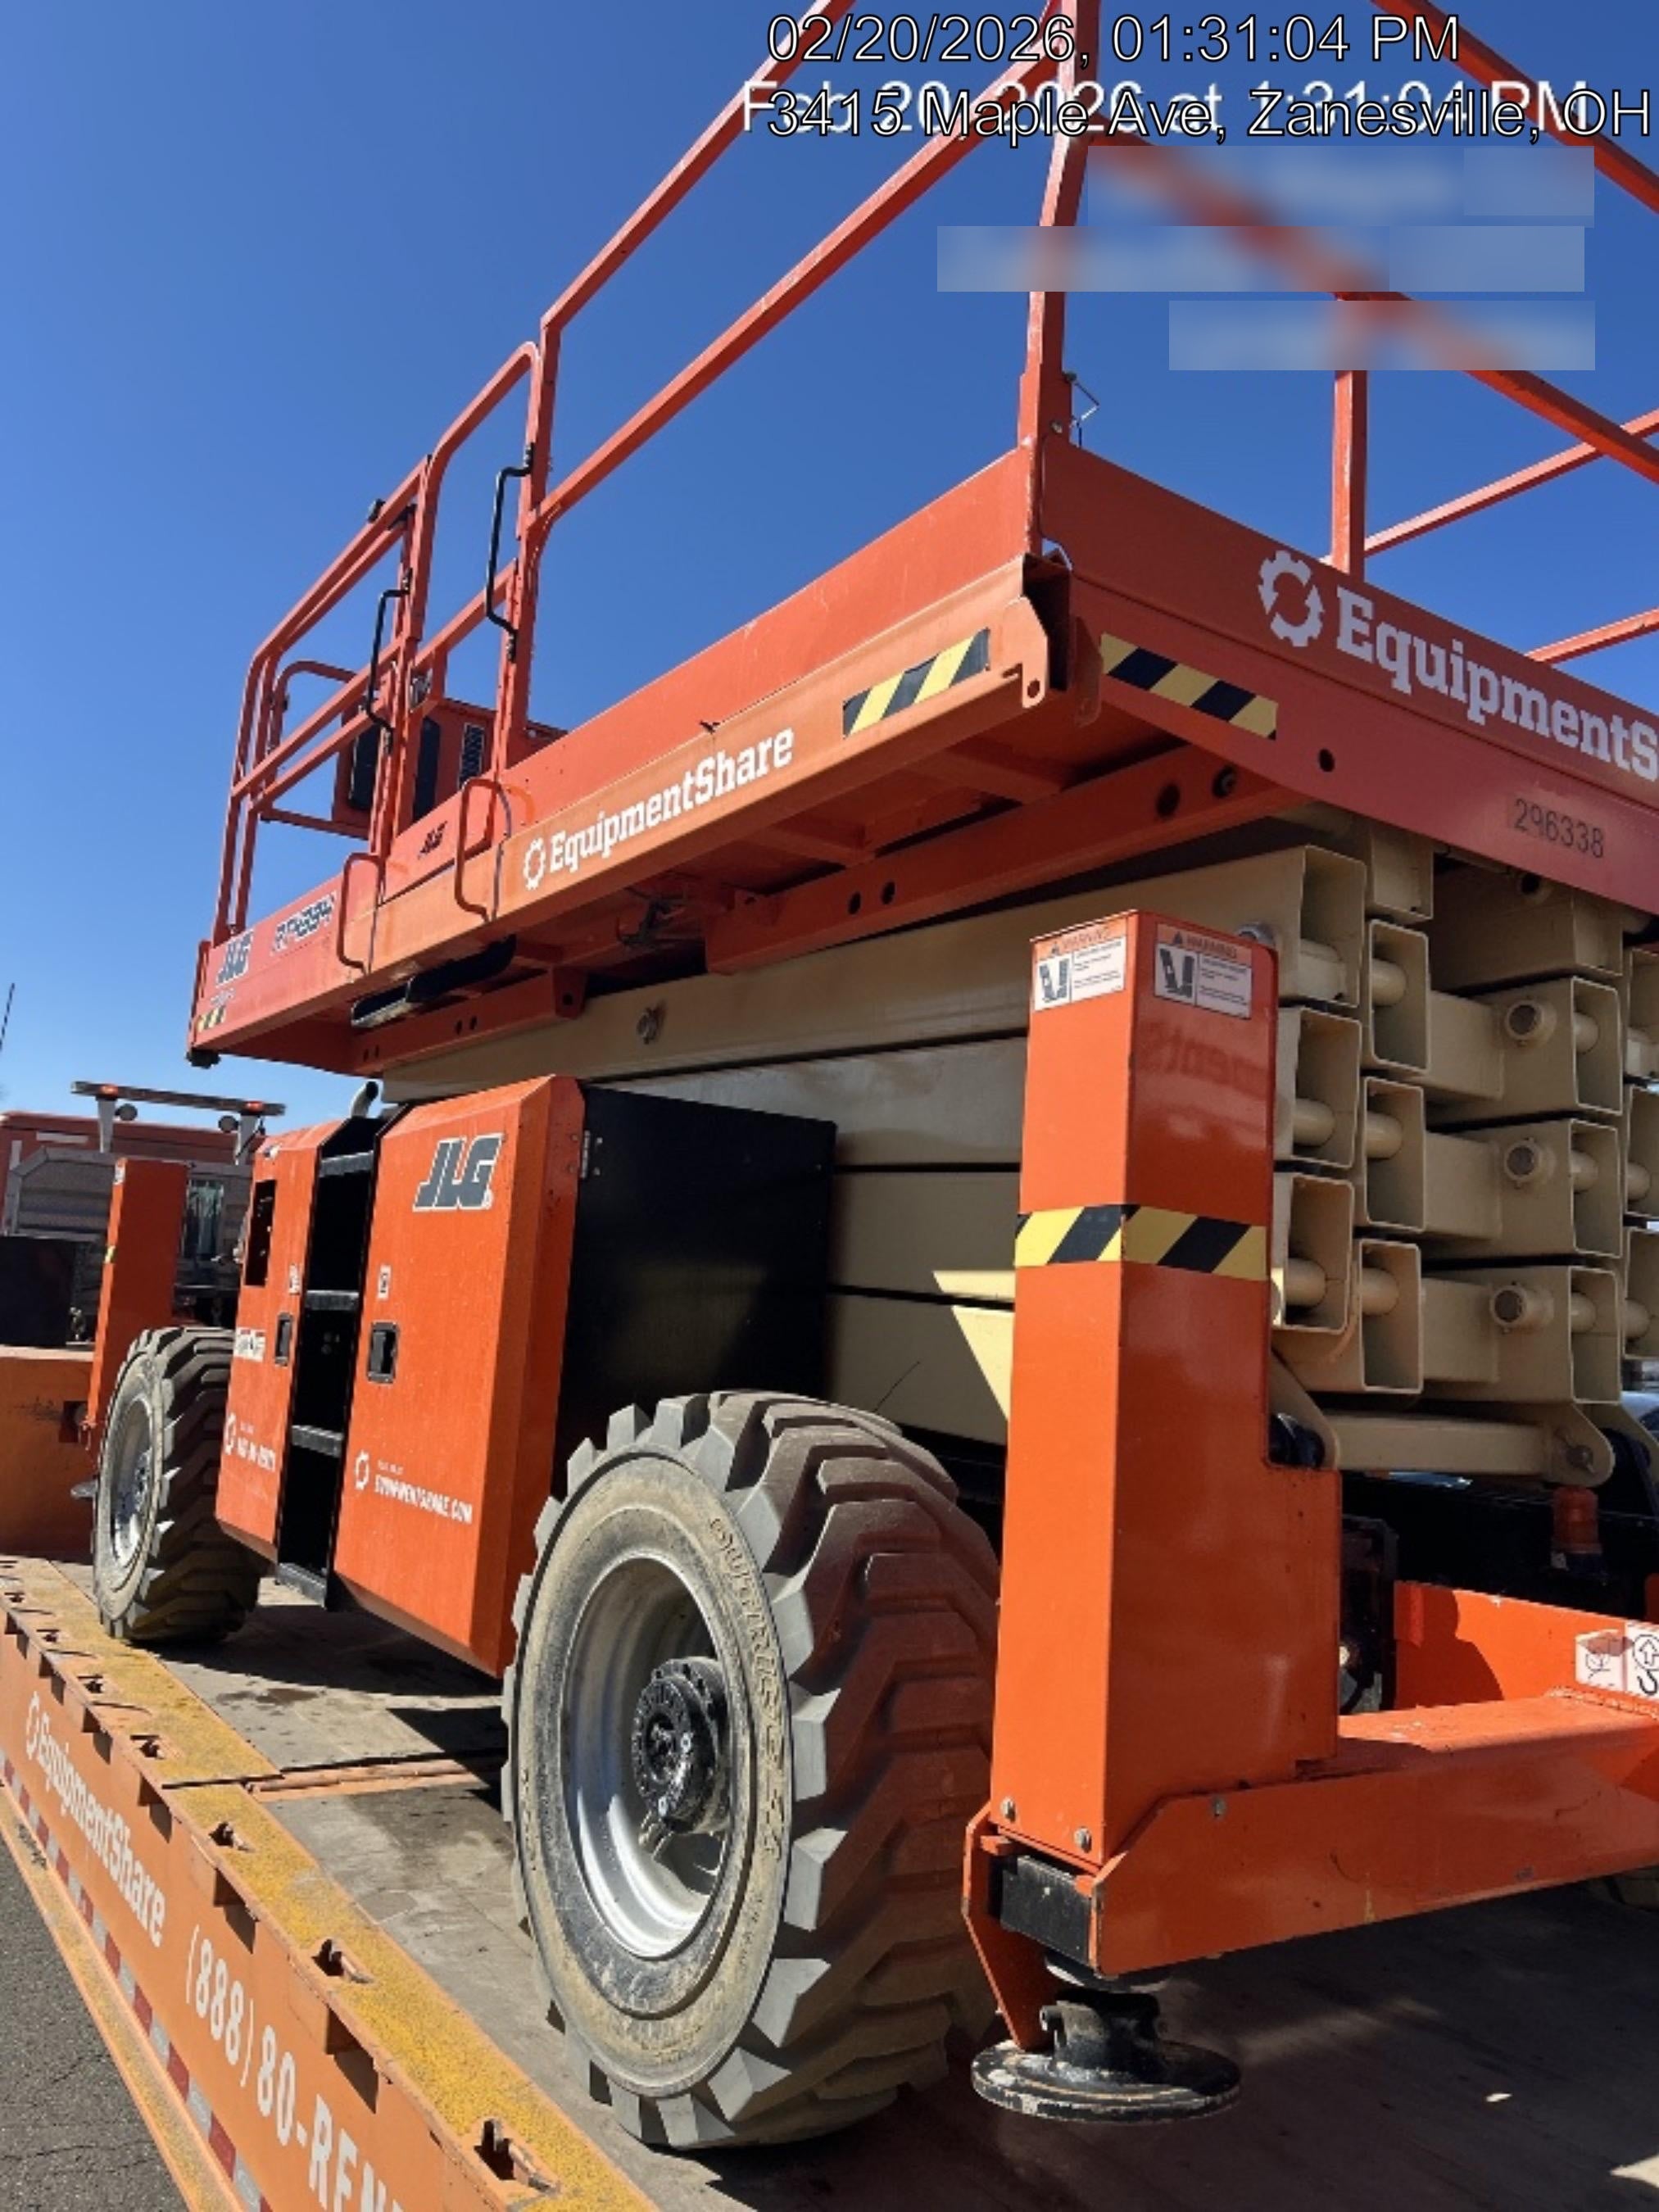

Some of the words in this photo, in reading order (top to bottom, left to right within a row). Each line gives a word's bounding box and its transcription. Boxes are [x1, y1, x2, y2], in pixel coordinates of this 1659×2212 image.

[550, 727, 795, 875] EquipmentShare
[1514, 798, 1603, 859] 296338
[412, 1132, 505, 1213] JLG
[38, 1711, 165, 1948] EquipmentShare
[186, 1924, 255, 2088] (888)
